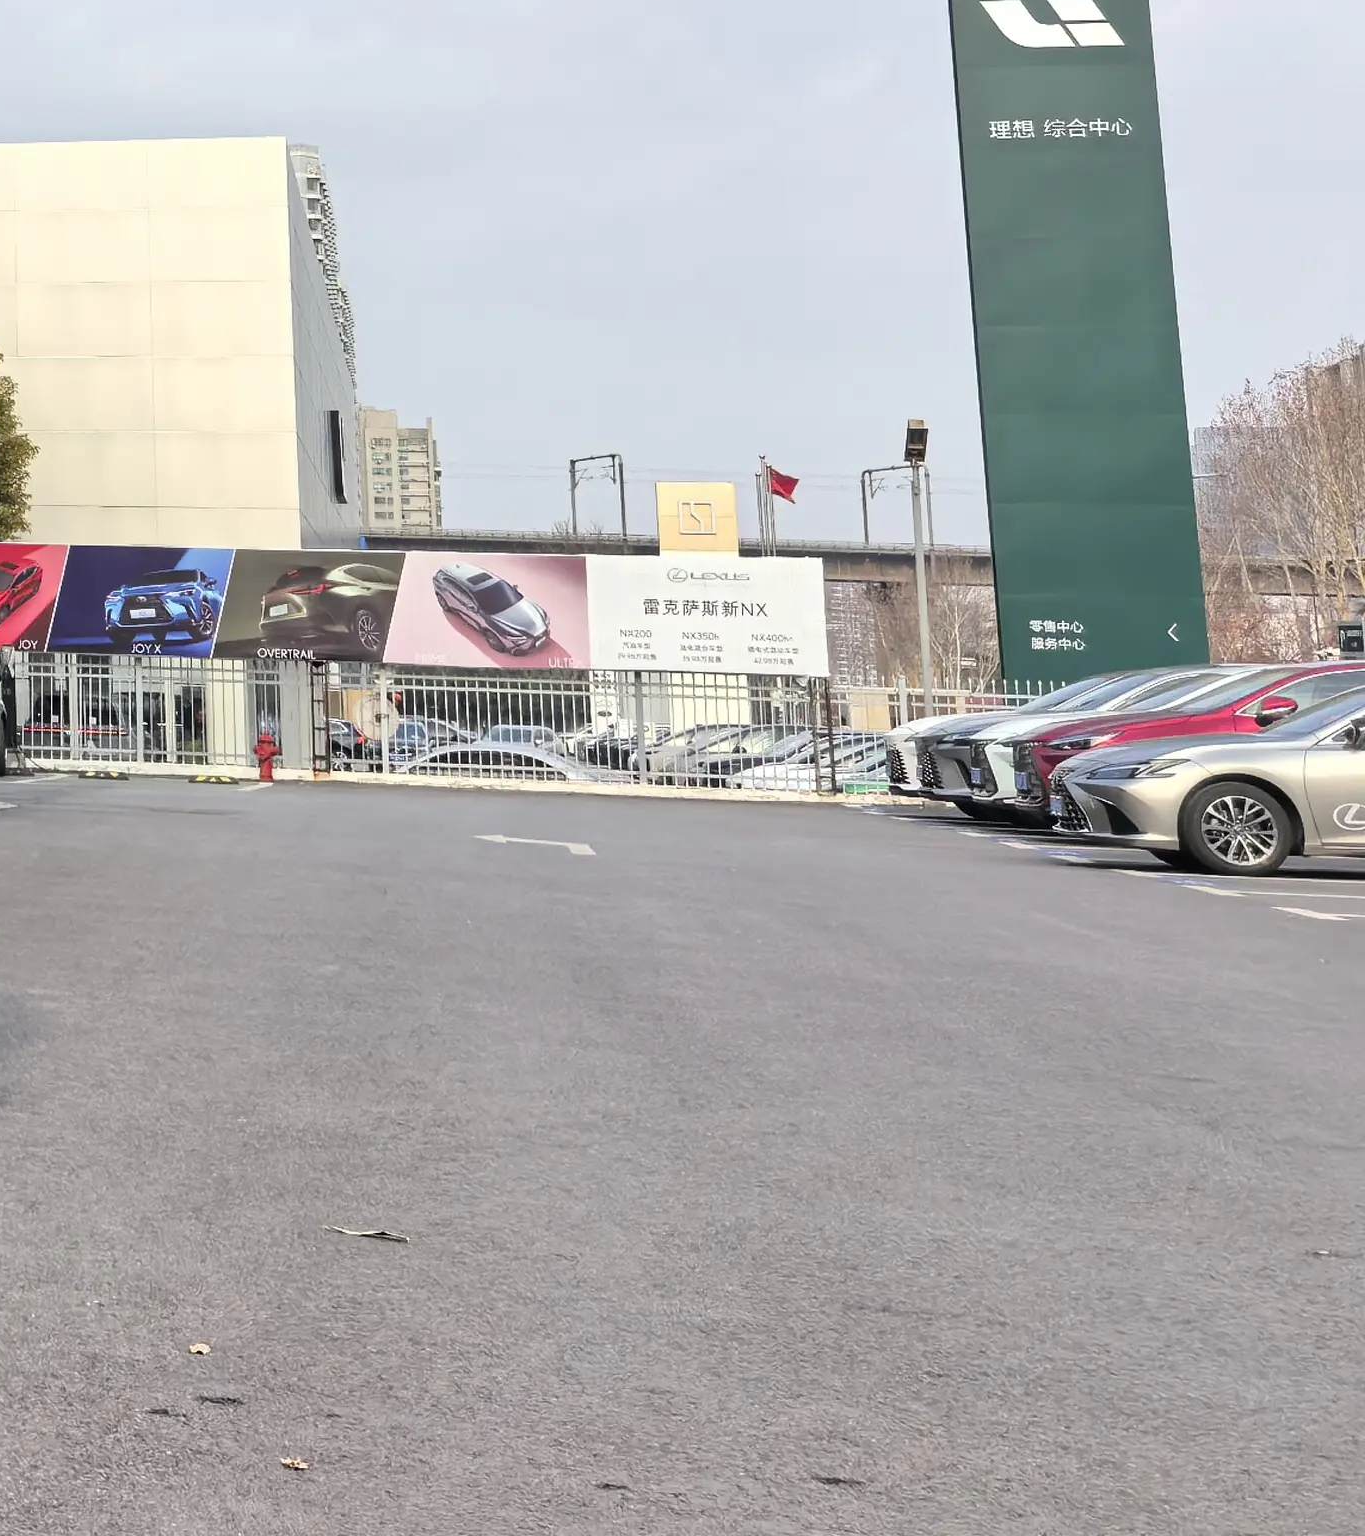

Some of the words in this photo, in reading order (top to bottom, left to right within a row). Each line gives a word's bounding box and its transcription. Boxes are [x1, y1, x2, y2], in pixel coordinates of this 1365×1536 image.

[988, 119, 1036, 140] 理想
[1043, 117, 1133, 138] 综合中心
[690, 571, 750, 581] LEXUS
[642, 598, 769, 618] 雷克萨斯新NX
[619, 628, 653, 639] NX200
[1029, 620, 1085, 634] 零售中心
[18, 639, 39, 650] JOY
[131, 643, 153, 654] JOY
[154, 643, 162, 654] X
[1031, 637, 1087, 651] 服务中心
[256, 647, 317, 660] OVERTRAIL
